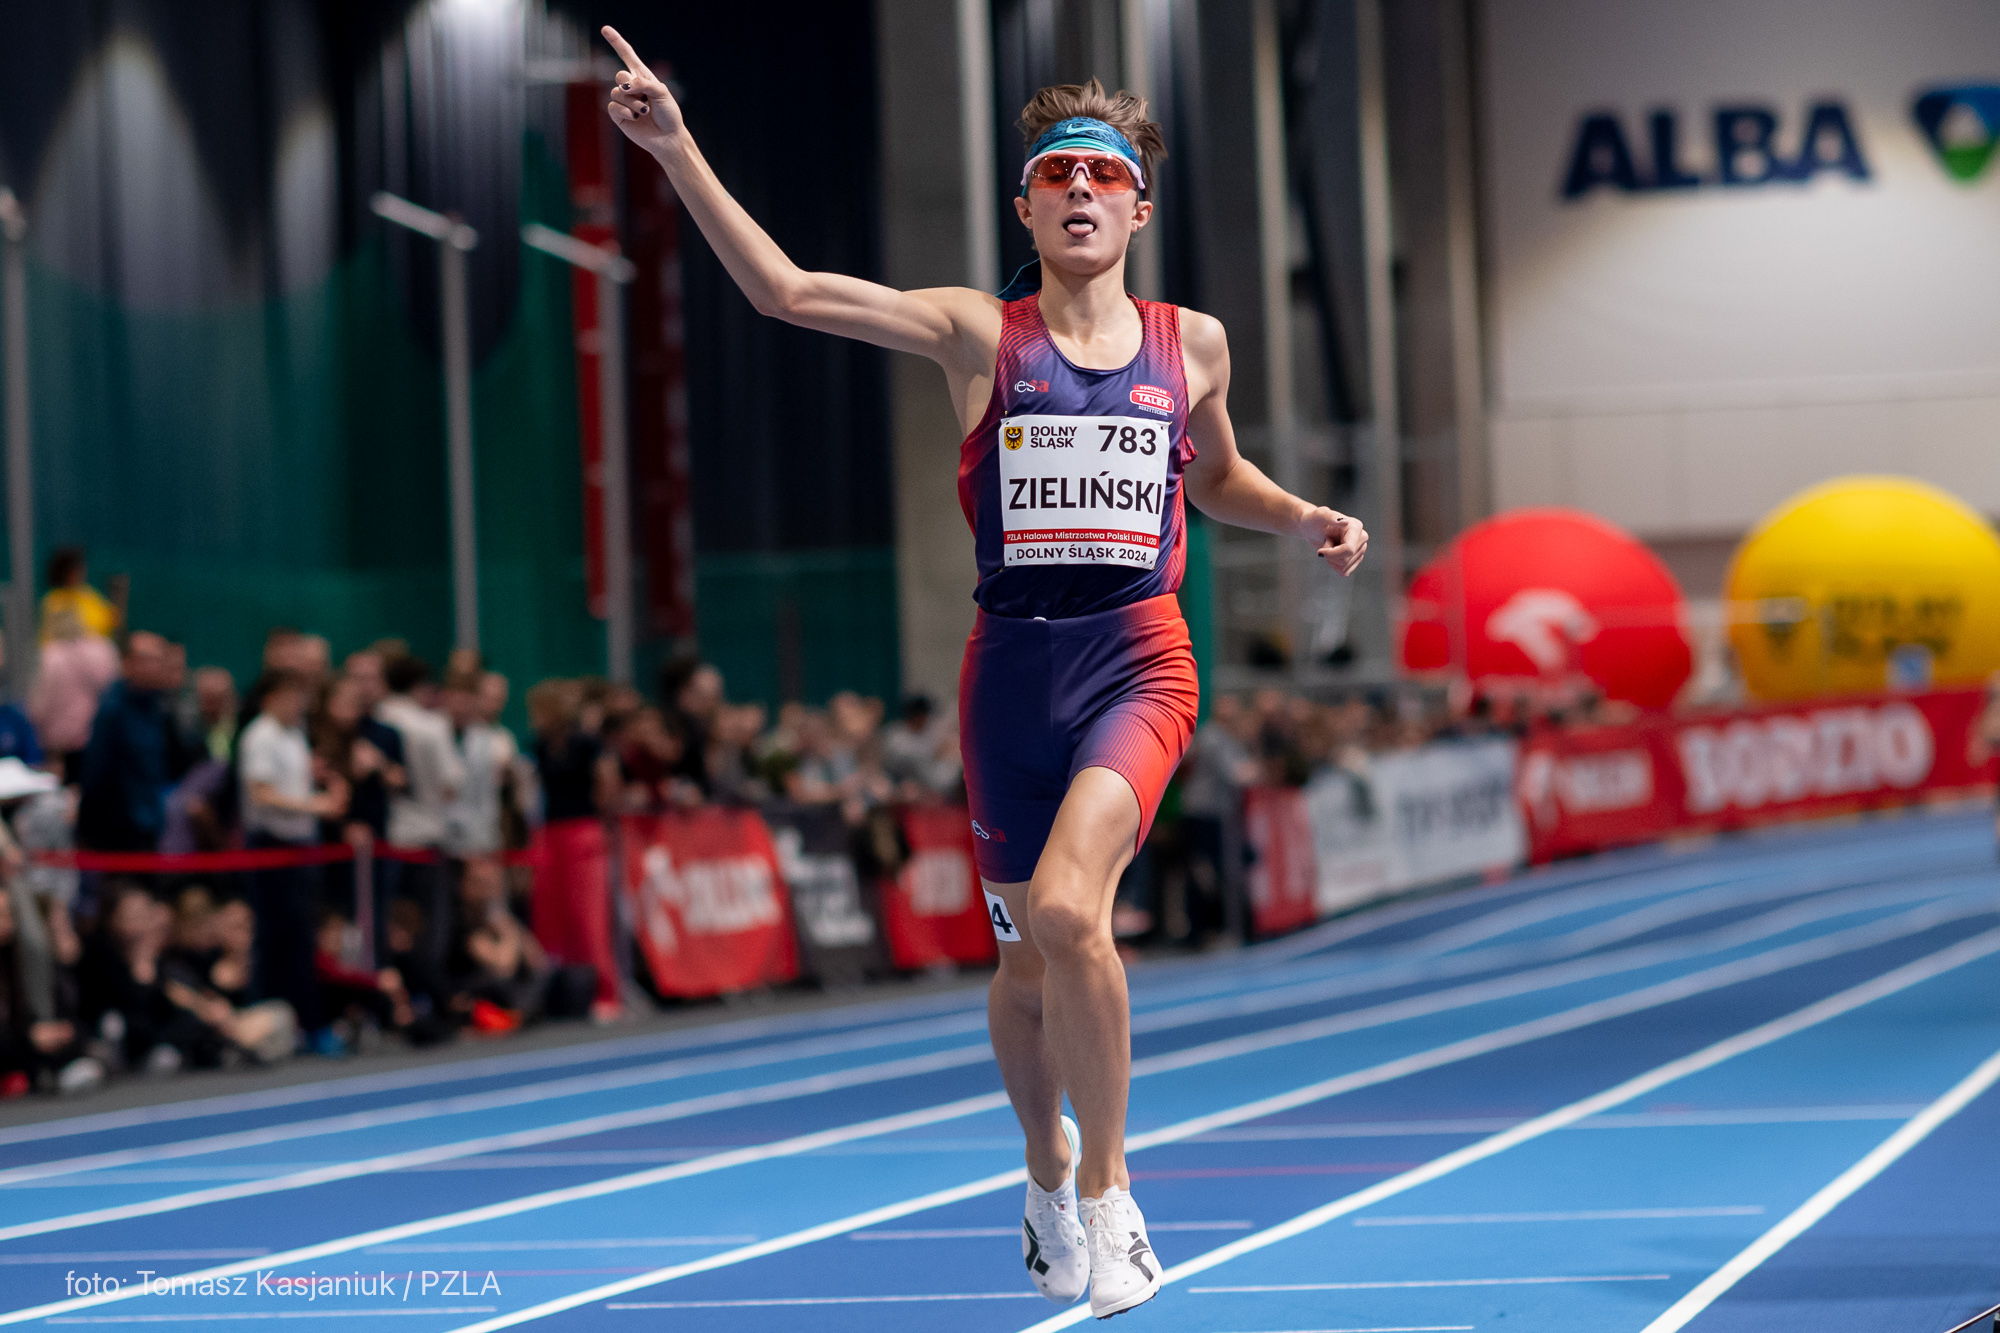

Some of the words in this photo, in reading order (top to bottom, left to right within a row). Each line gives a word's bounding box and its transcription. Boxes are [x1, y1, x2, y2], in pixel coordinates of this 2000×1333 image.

[1563, 106, 1872, 199] ALBA
[1136, 392, 1170, 409] TALEX
[1030, 426, 1078, 437] DOLNY
[1098, 425, 1157, 456] 783
[1030, 435, 1075, 450] ŚLĄSK
[1009, 471, 1162, 515] ZIELIŃSKI
[1023, 532, 1053, 540] Halowe
[1055, 531, 1105, 540] Mistrzostwa
[1107, 532, 1130, 541] Polski
[1131, 534, 1142, 543] U18
[1146, 537, 1157, 546] U20
[1016, 547, 1065, 559] DOLNY
[1068, 544, 1115, 561] ŚLĄSK
[1119, 548, 1147, 562] 2024
[992, 902, 1013, 934] 4
